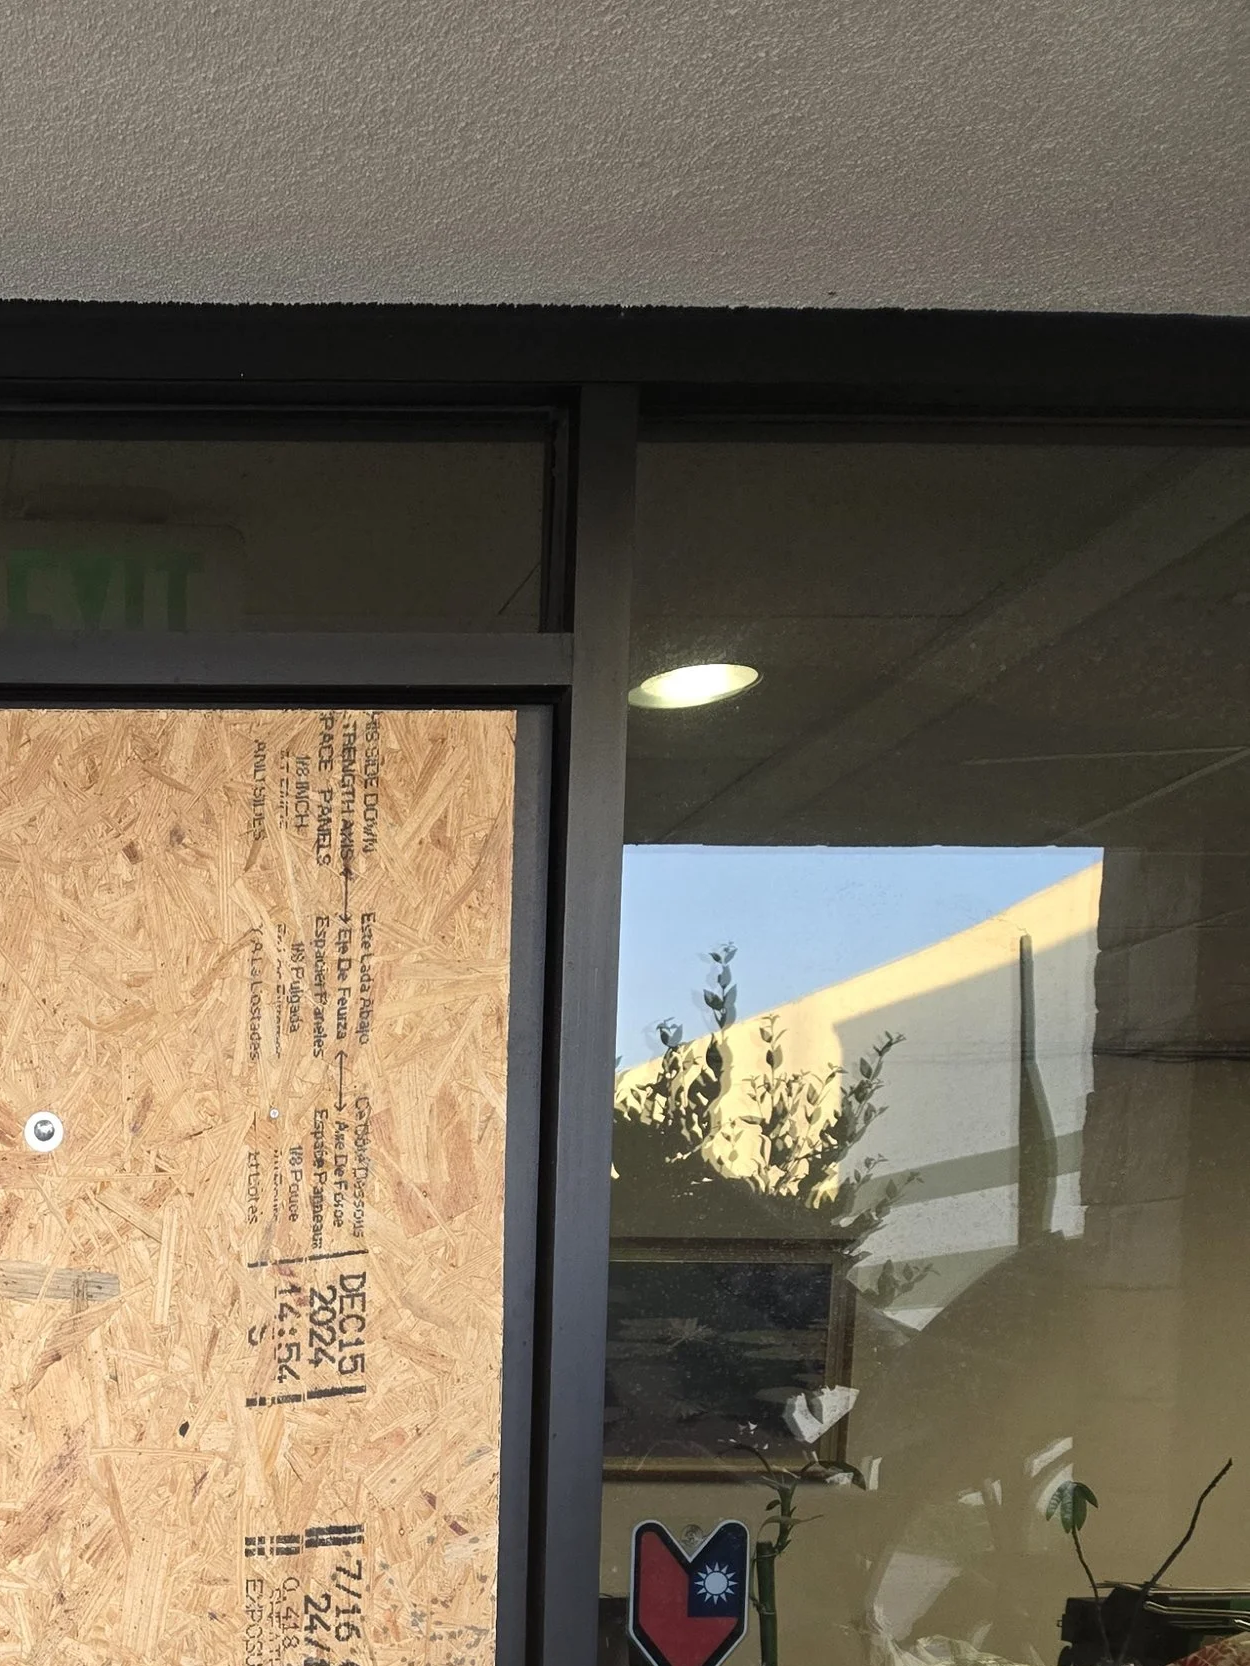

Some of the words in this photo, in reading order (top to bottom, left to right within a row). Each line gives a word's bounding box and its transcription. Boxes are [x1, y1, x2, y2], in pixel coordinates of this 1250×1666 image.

[294, 782, 310, 830] INCH
[316, 790, 333, 866] PANELS
[362, 793, 379, 853] DOWN
[360, 913, 376, 951] Este
[287, 966, 305, 1034] Pulgada
[336, 959, 352, 982] De
[288, 1169, 304, 1223] Pouce
[272, 1284, 303, 1385] 14:54
[307, 1283, 338, 1369] 2024
[336, 1271, 367, 1376] DEC15
[281, 1575, 301, 1652] 0.418
[333, 1558, 364, 1643] 7/16
